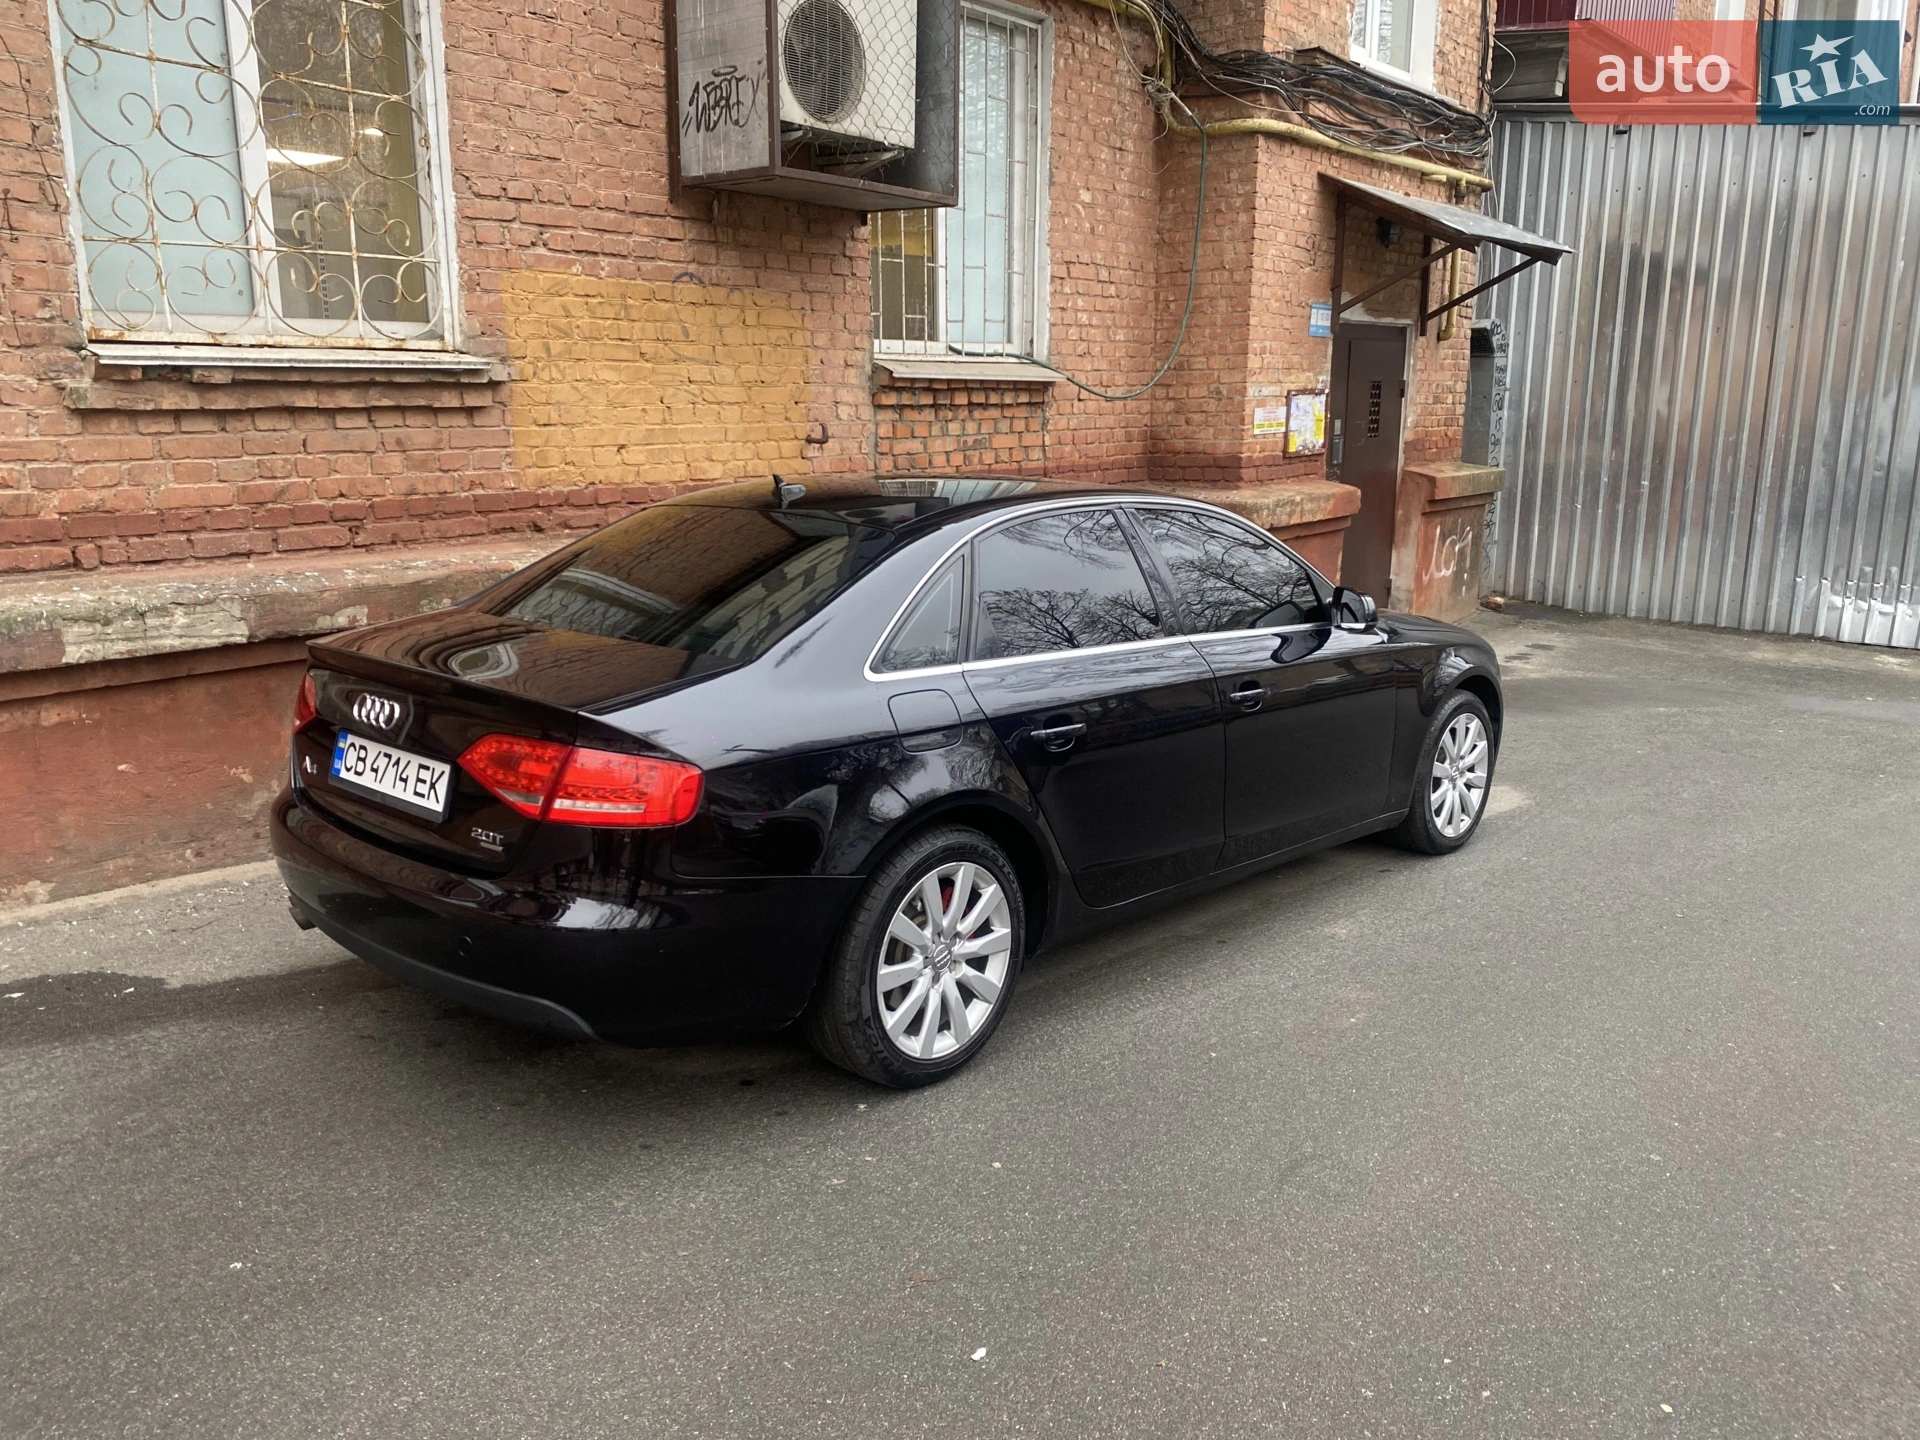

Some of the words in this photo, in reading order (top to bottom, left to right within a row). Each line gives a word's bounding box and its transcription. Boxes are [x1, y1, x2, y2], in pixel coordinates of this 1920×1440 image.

[343, 741, 369, 777] CB
[369, 750, 412, 793] 4714
[412, 763, 446, 804] EK
